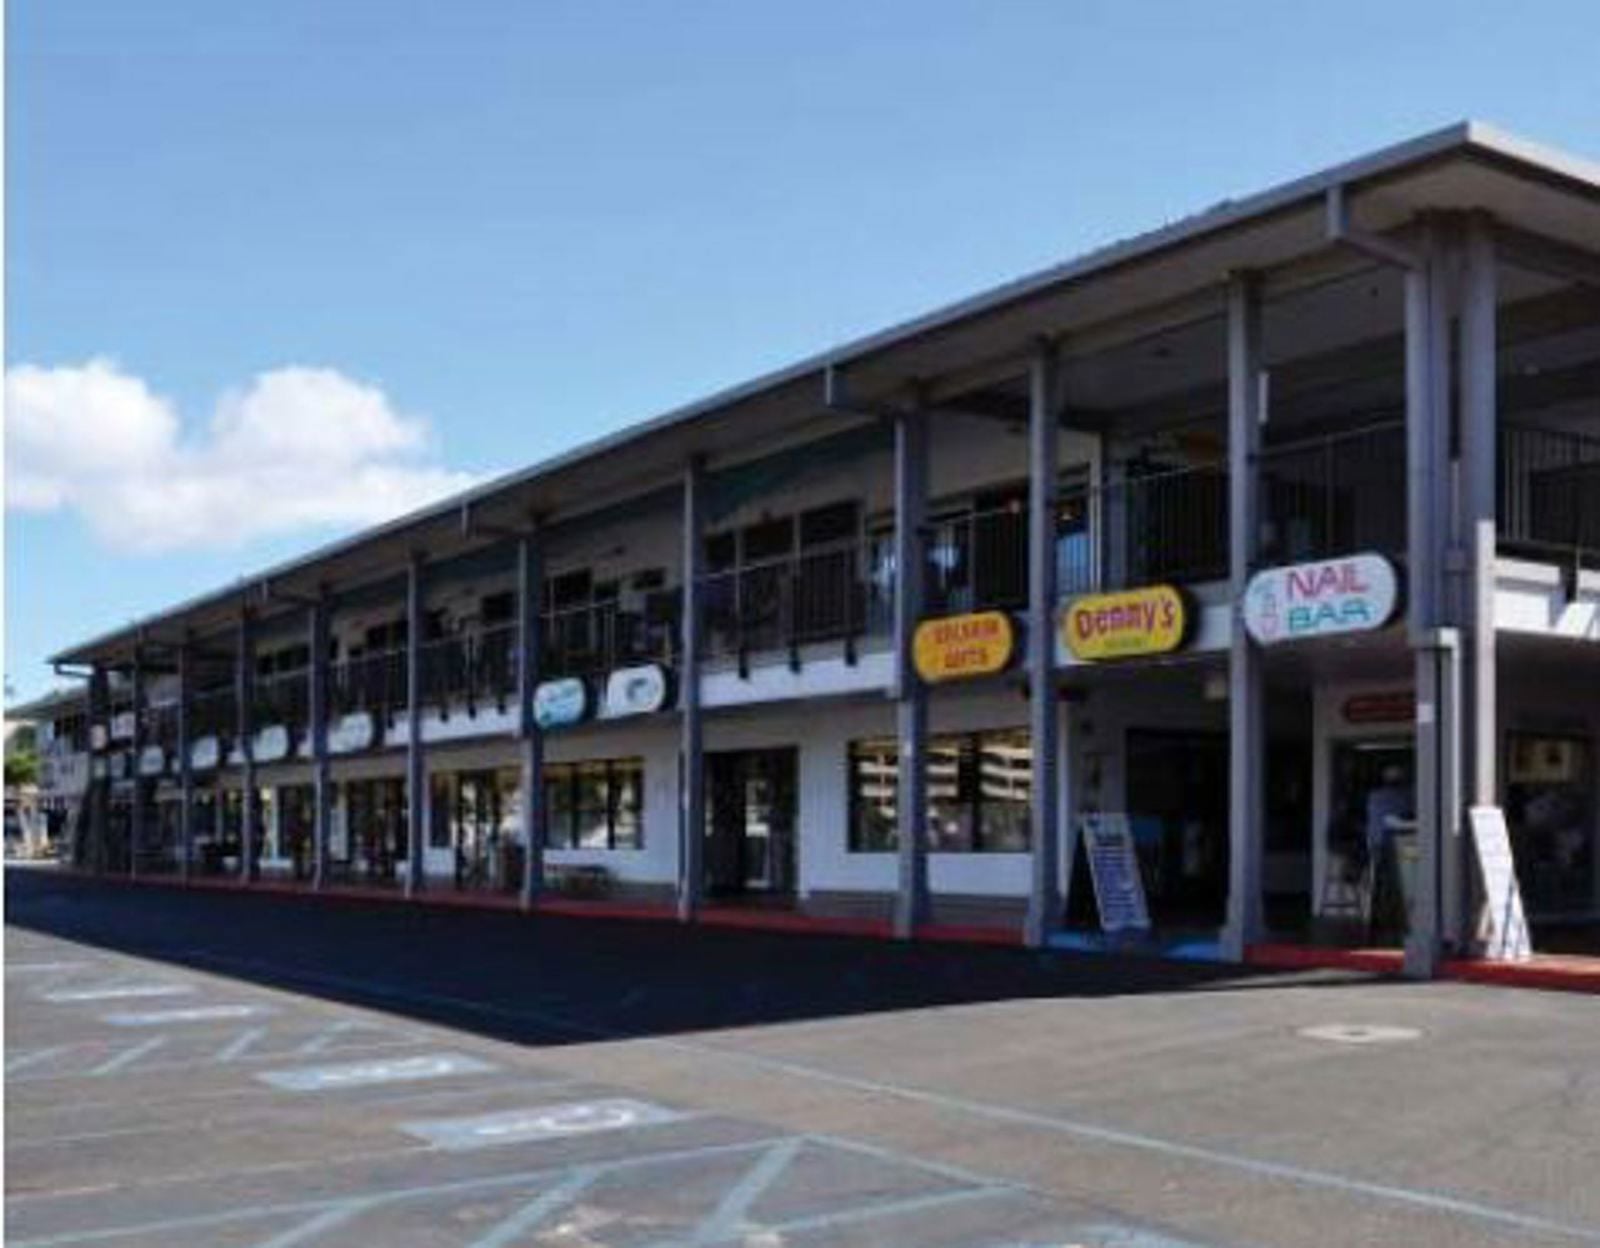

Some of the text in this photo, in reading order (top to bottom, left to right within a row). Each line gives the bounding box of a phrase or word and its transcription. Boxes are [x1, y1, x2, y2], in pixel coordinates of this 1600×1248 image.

[1287, 564, 1369, 600] NAIL
[1076, 595, 1174, 640] Denny's
[1288, 597, 1371, 631] BAR
